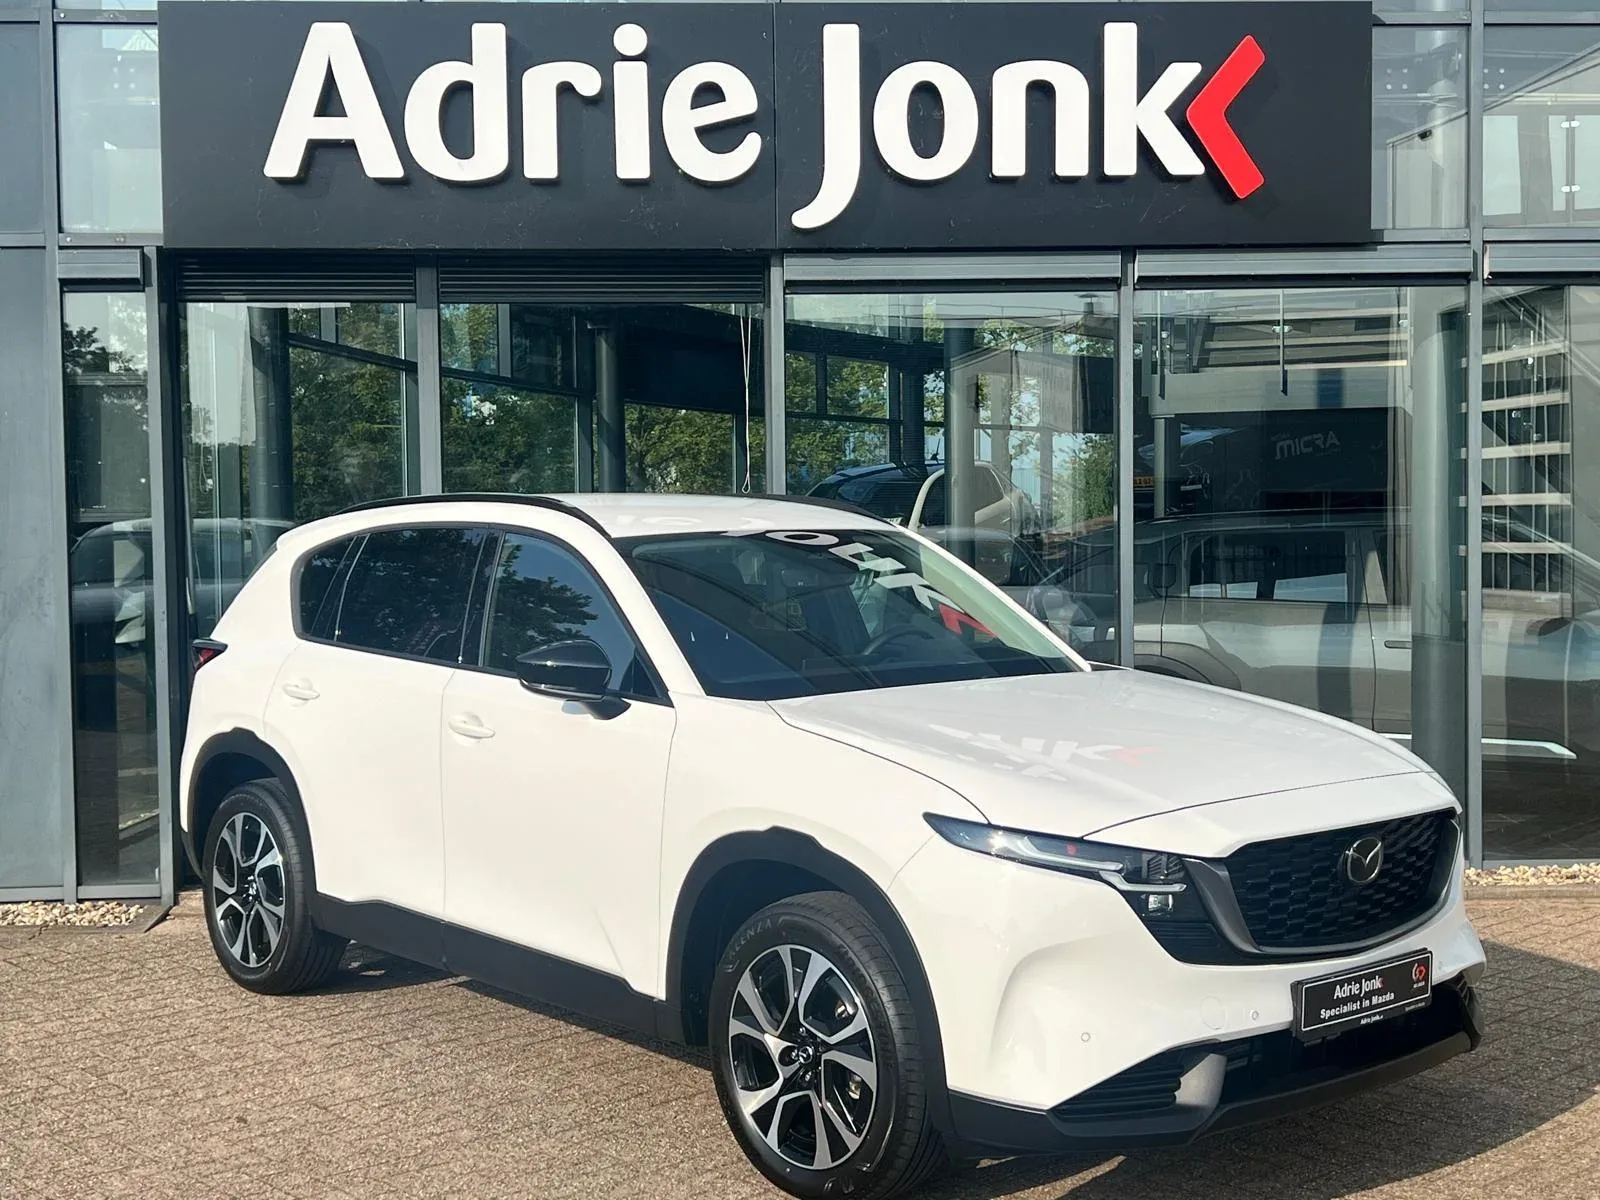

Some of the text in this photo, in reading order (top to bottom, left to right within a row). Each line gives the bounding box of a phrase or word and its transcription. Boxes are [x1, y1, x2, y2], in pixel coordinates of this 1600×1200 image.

[264, 22, 1206, 229] Adrie Jonk
[1333, 975, 1383, 999] Adrie Jonk
[1320, 992, 1394, 1019] Specialist in Mazda
